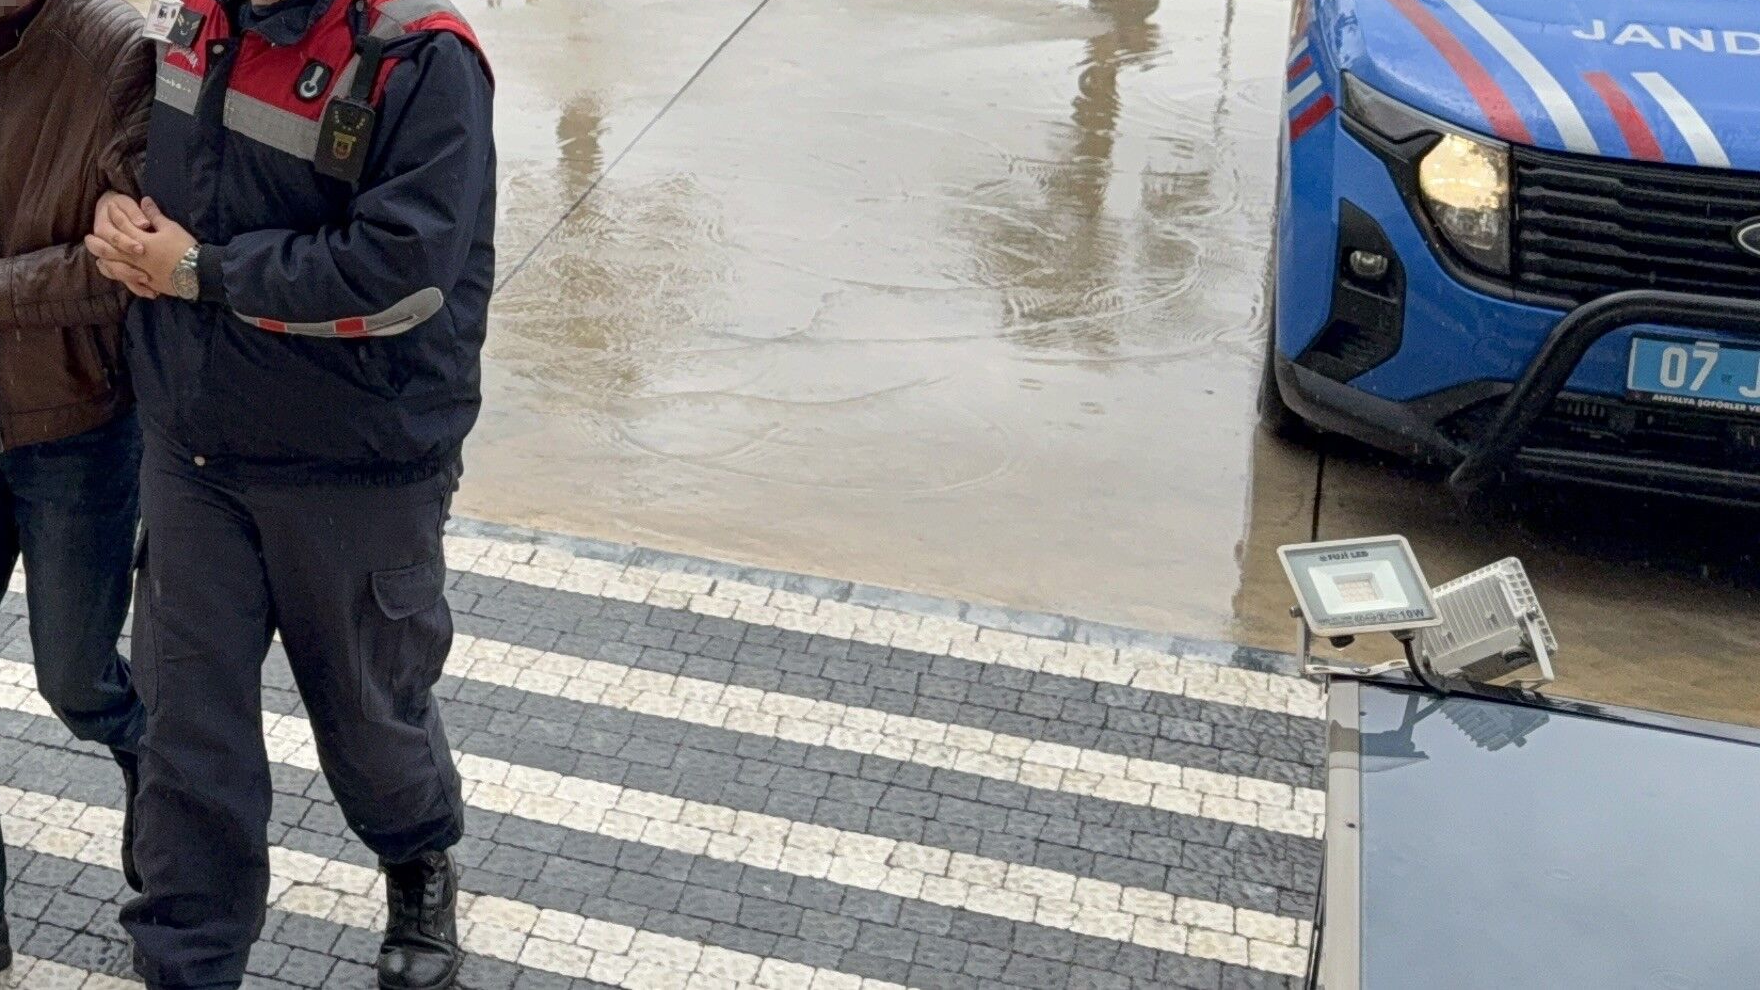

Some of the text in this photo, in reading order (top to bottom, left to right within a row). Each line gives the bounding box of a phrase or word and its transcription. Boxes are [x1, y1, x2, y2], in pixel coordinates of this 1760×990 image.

[1661, 347, 1718, 391] 07
[1652, 394, 1695, 405] ANTALYA
[1400, 609, 1425, 619] 10W
